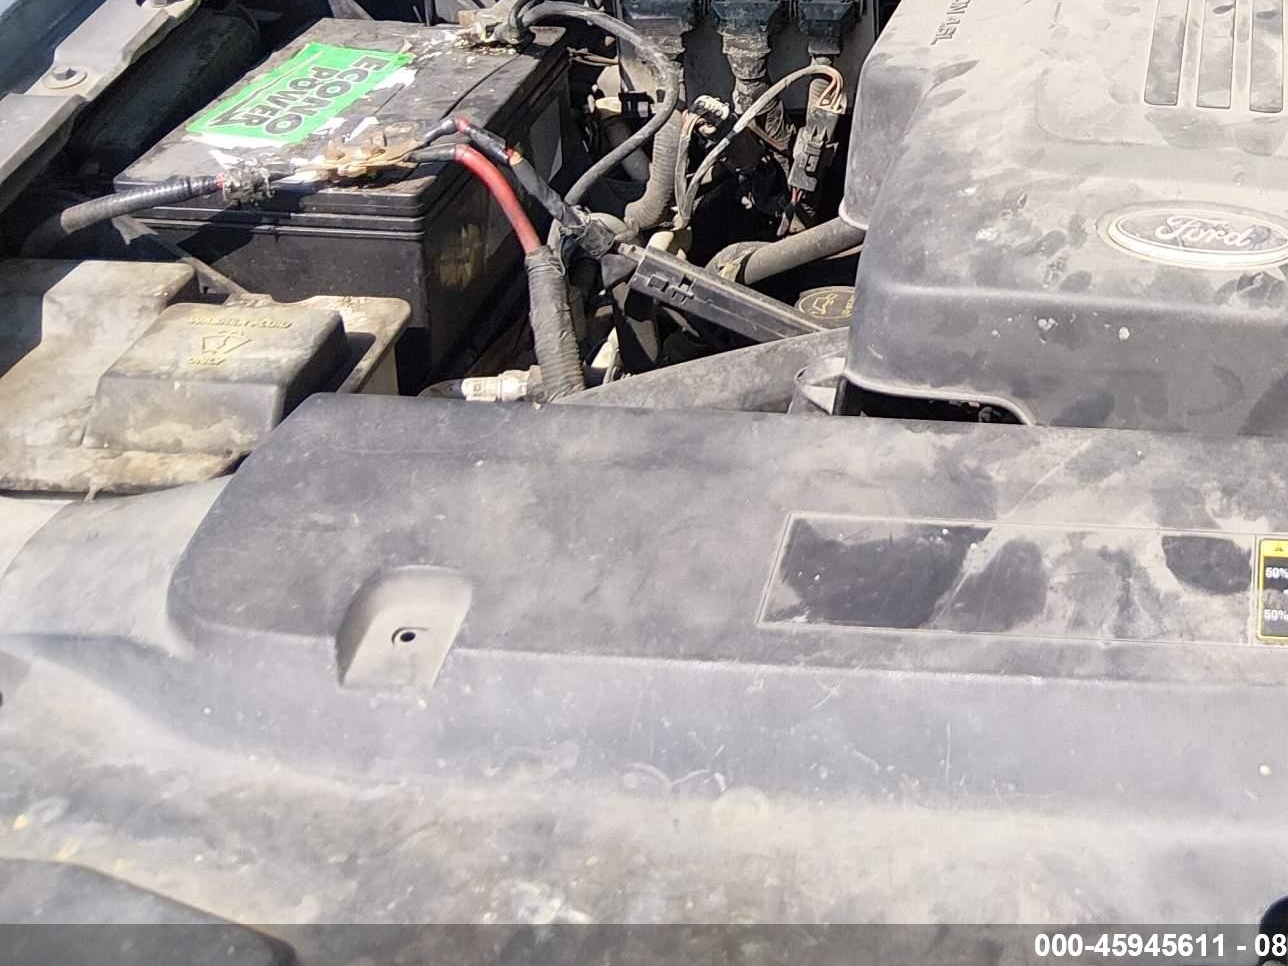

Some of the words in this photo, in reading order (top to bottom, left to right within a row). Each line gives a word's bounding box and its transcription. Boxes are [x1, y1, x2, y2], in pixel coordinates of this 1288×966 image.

[243, 65, 342, 129] POWER
[263, 54, 393, 136] ECONO
[1155, 215, 1256, 248] Ford
